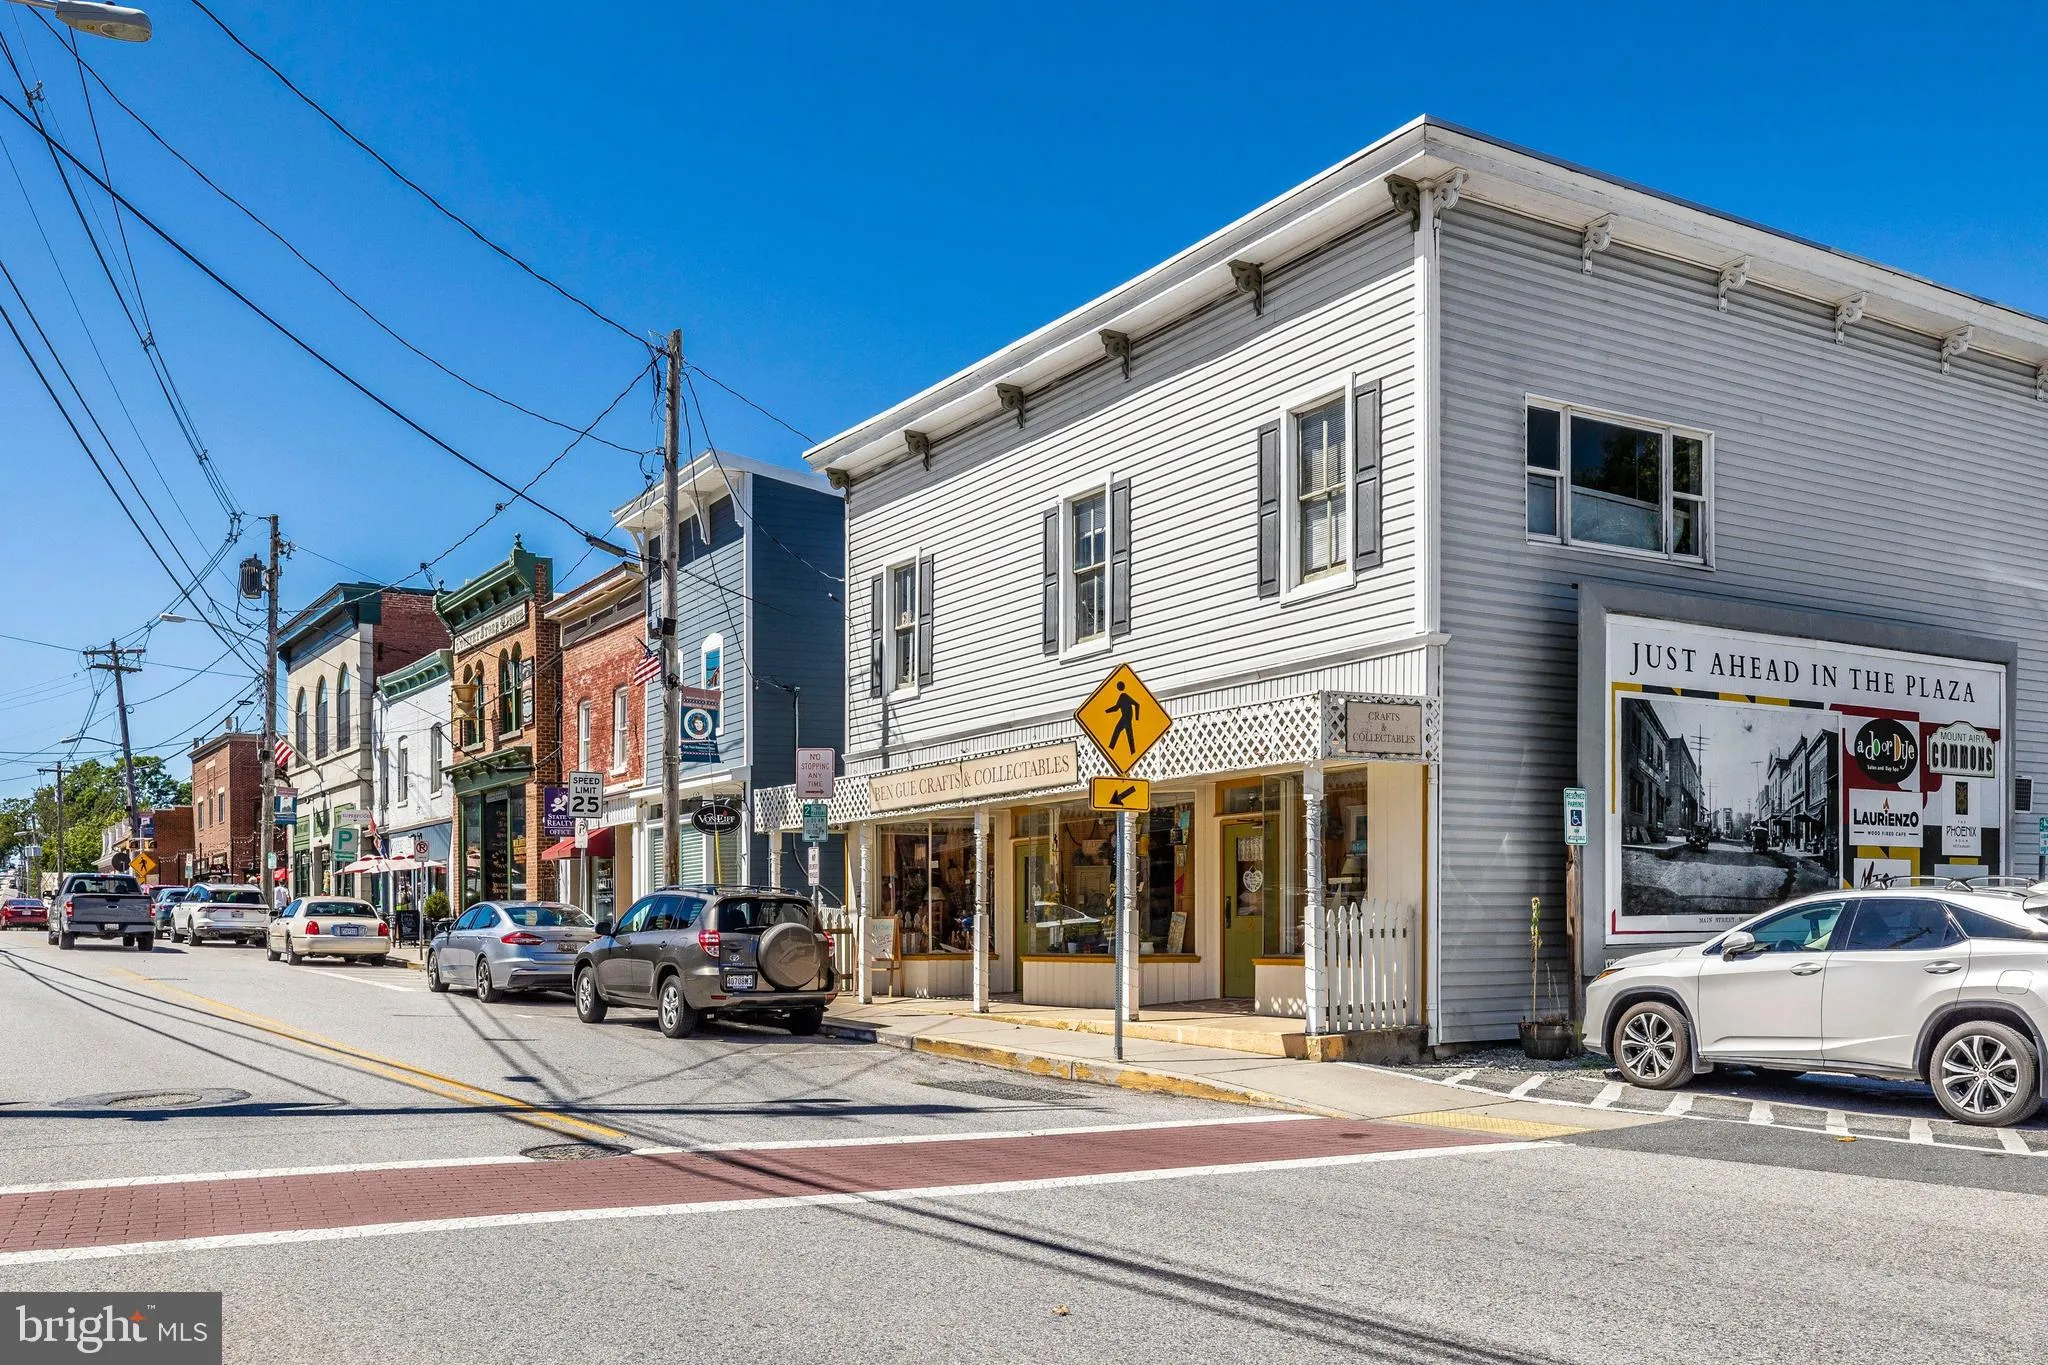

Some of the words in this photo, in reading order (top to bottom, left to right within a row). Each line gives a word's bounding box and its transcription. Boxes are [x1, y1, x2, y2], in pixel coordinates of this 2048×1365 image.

[1630, 642, 1696, 676] JUST
[1710, 652, 1799, 684] AHEAD
[1812, 663, 1837, 688] IN
[1849, 668, 1895, 694] THE
[1905, 674, 1975, 703] PLAZA
[1368, 711, 1400, 722] CRAFTS
[1381, 723, 1387, 732] &
[1353, 731, 1416, 744] COLLECTABLES
[1940, 732, 1967, 742] MOUNT
[1968, 734, 1985, 743] AIRY
[1931, 741, 1993, 772] COMMONS
[800, 762, 830, 770] STOPPING
[573, 777, 600, 785] SPEED
[874, 786, 893, 802] BEN
[895, 780, 917, 798] GUE
[919, 772, 961, 795] CRAFTS
[963, 771, 971, 788] &
[974, 754, 1070, 786] COLLECTABLES
[575, 787, 597, 795] LIMIT
[572, 796, 600, 813] 25
[804, 806, 811, 816] 2
[1946, 825, 1977, 837] PHOENIX
[338, 830, 353, 850] P
